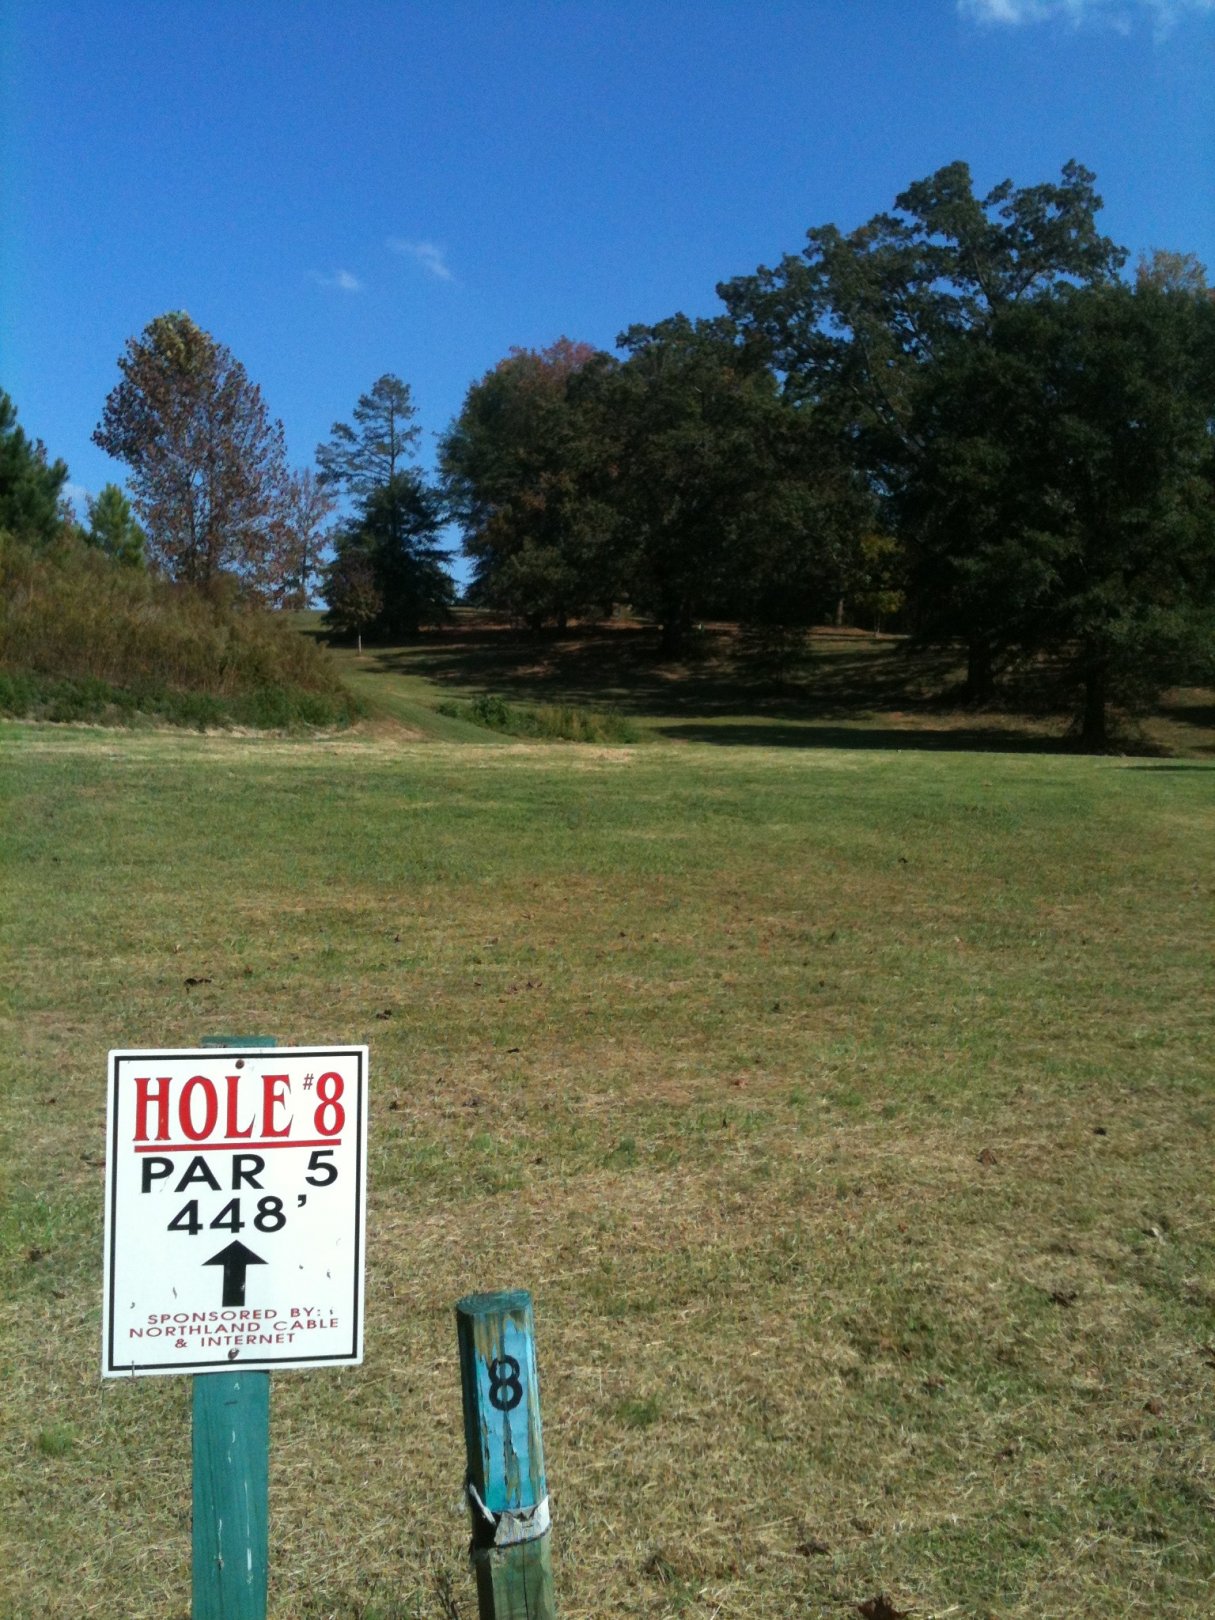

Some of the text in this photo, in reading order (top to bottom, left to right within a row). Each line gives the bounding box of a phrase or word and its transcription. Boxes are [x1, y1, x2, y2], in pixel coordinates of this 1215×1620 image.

[133, 1071, 346, 1141] HOLE #8
[141, 1150, 338, 1193] PAR 5
[167, 1194, 307, 1236] 448'
[129, 1318, 339, 1338] NORTHLAND CABLE
[147, 1307, 321, 1325] SPONSORED BY:
[175, 1333, 295, 1348] & INTERNET
[488, 1354, 523, 1412] 8
